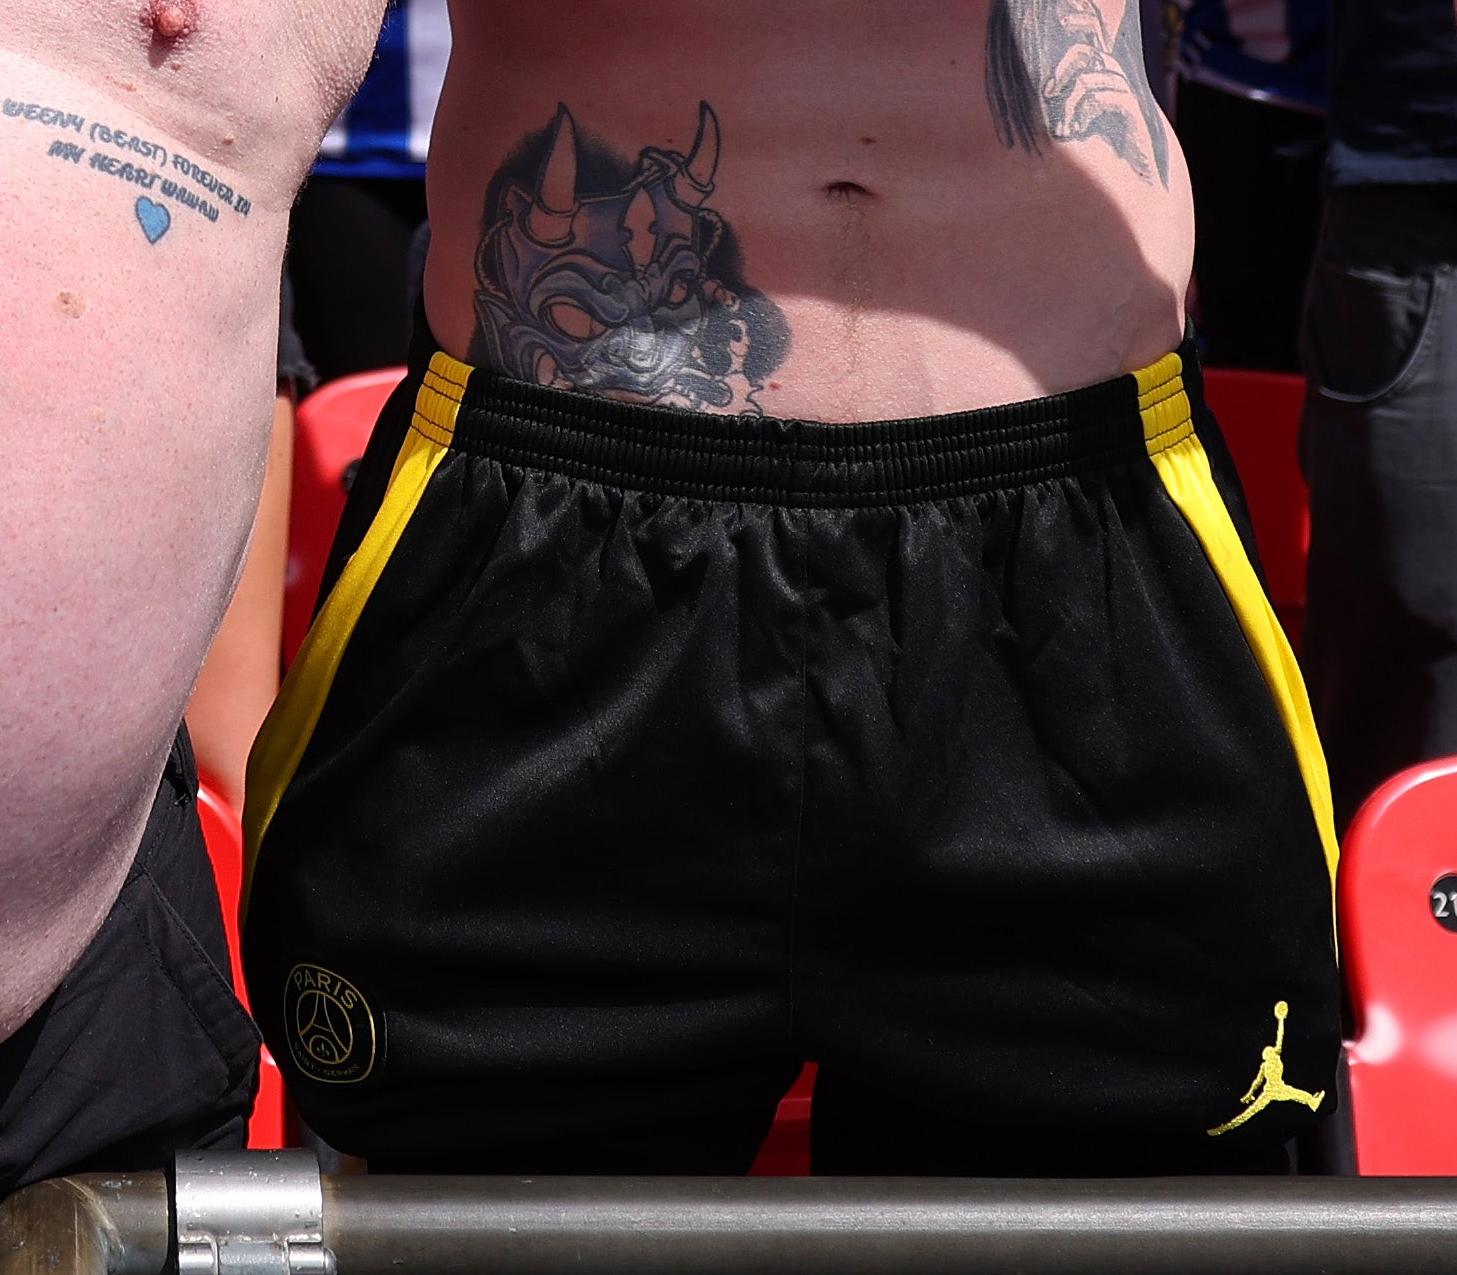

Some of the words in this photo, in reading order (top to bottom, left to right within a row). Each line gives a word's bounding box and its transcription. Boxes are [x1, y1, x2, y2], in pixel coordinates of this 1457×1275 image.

[89, 151, 163, 190] HEART
[172, 153, 235, 206] FOREVER
[233, 194, 253, 217] IN
[294, 969, 358, 1010] PARIS
